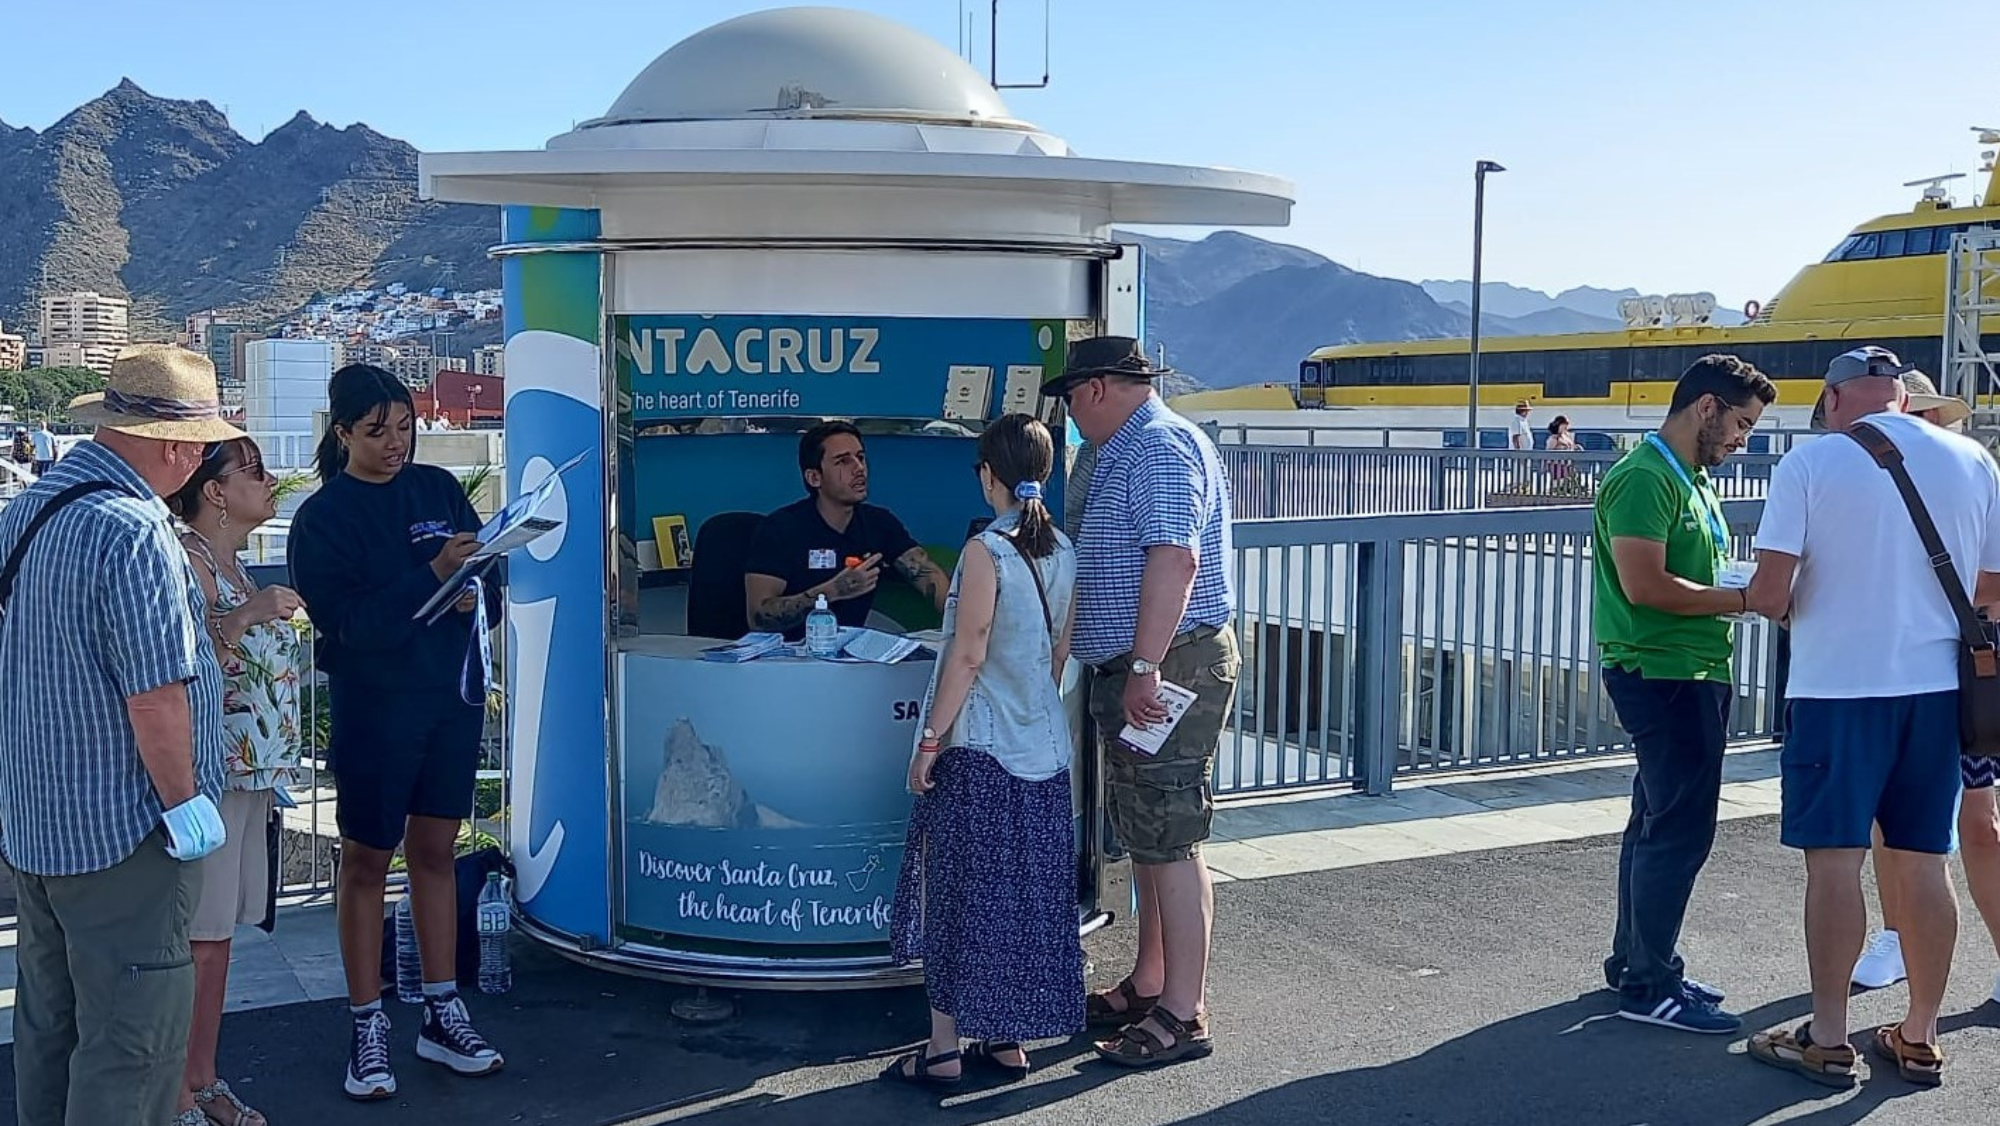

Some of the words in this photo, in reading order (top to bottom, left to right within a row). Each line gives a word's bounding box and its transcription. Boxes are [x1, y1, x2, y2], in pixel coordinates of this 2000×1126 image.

[631, 390, 655, 411] he
[659, 390, 702, 409] heart
[707, 389, 726, 409] of
[727, 388, 800, 408] Tenerife
[638, 850, 716, 883] Discover
[718, 859, 785, 887] Santa
[788, 862, 838, 890] Cruz,
[678, 891, 714, 921] the
[715, 892, 779, 927] heart
[780, 897, 805, 932] of
[808, 896, 893, 930] Tenerife
